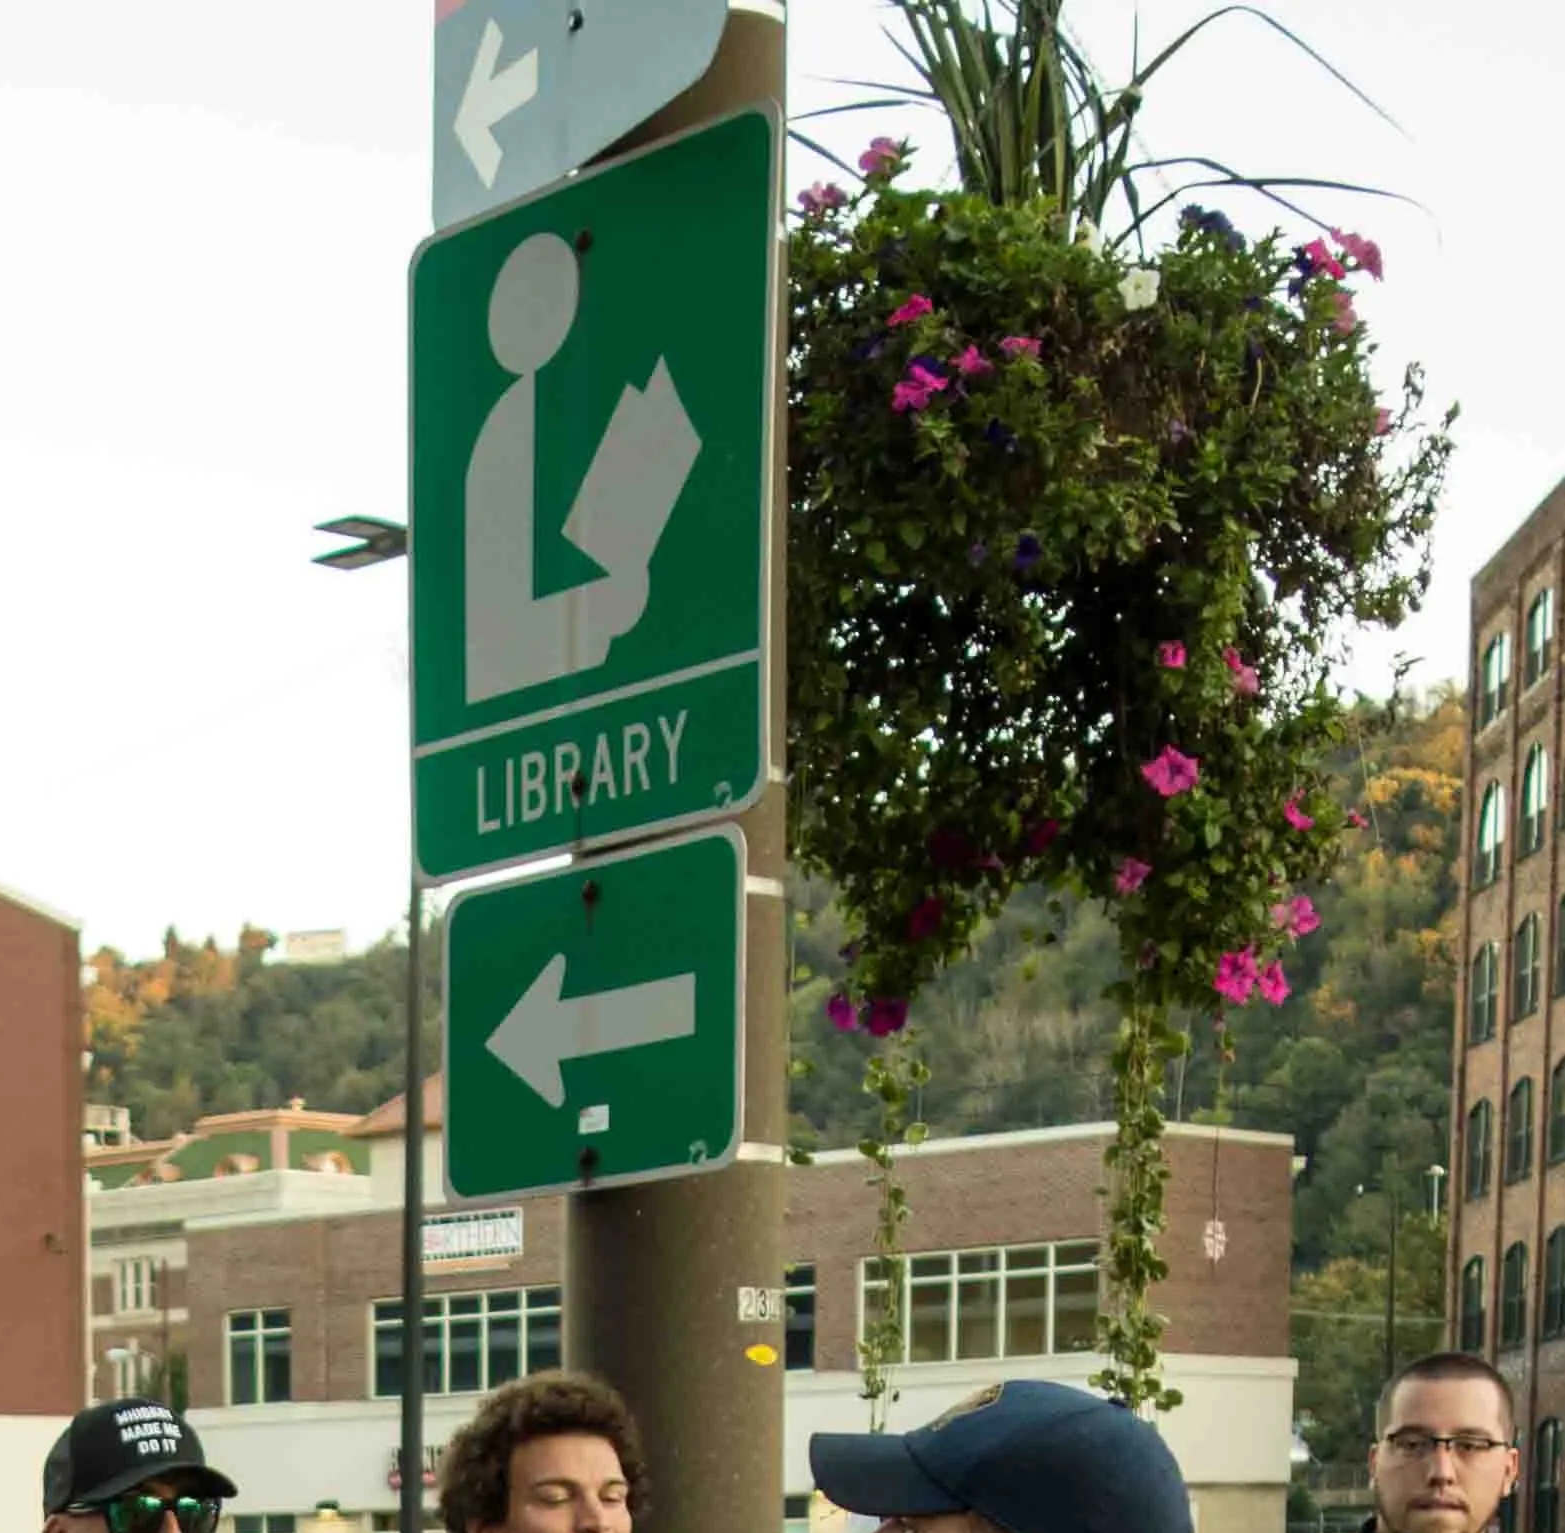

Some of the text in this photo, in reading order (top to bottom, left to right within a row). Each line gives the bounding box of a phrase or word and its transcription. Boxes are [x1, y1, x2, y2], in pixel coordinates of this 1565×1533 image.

[476, 709, 688, 836] LIBRARY
[120, 1421, 183, 1443] MADE ME
[137, 1438, 177, 1455] DO IT
